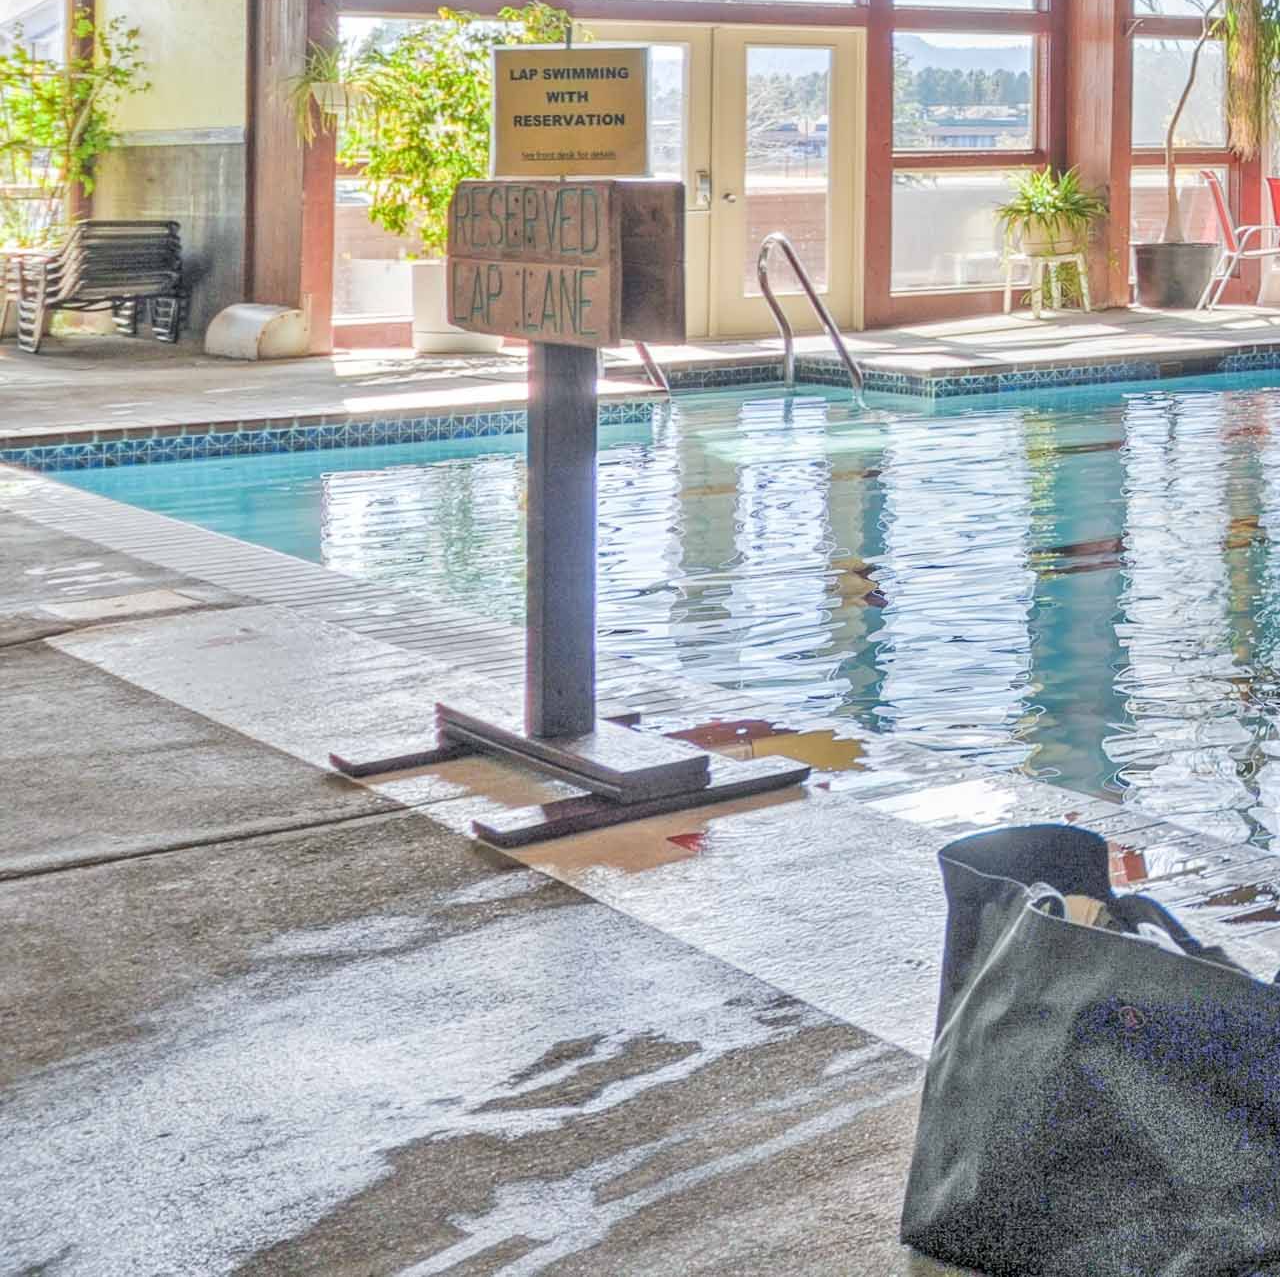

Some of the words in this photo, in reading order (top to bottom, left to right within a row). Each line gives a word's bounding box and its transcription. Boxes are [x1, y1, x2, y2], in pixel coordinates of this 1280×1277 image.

[509, 69, 538, 81] LAP
[543, 67, 629, 80] SWIMMING
[546, 91, 589, 103] WITH
[513, 113, 626, 127] RESERVATION
[454, 185, 599, 254] RESERVED
[453, 262, 503, 326] LAP
[522, 268, 598, 336] LANE
